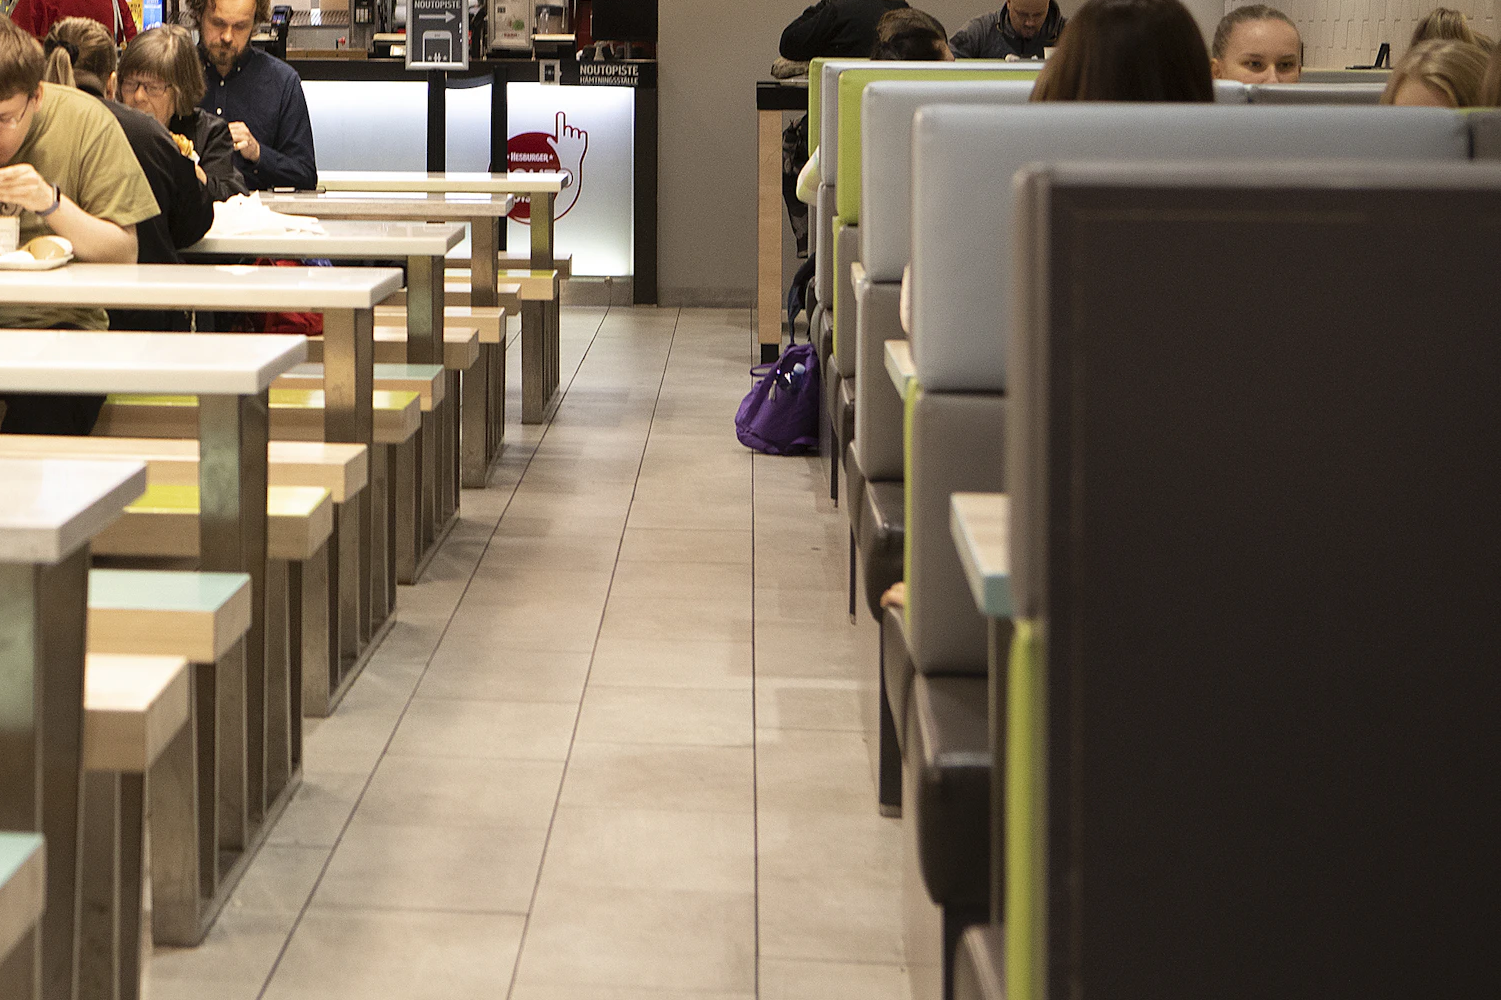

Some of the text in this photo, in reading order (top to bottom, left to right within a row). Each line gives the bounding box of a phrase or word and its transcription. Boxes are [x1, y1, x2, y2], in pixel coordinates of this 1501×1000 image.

[414, 0, 461, 10] NOUTOPISTE
[579, 65, 639, 76] NOUTOPISTE
[510, 151, 549, 163] HESBURGER
